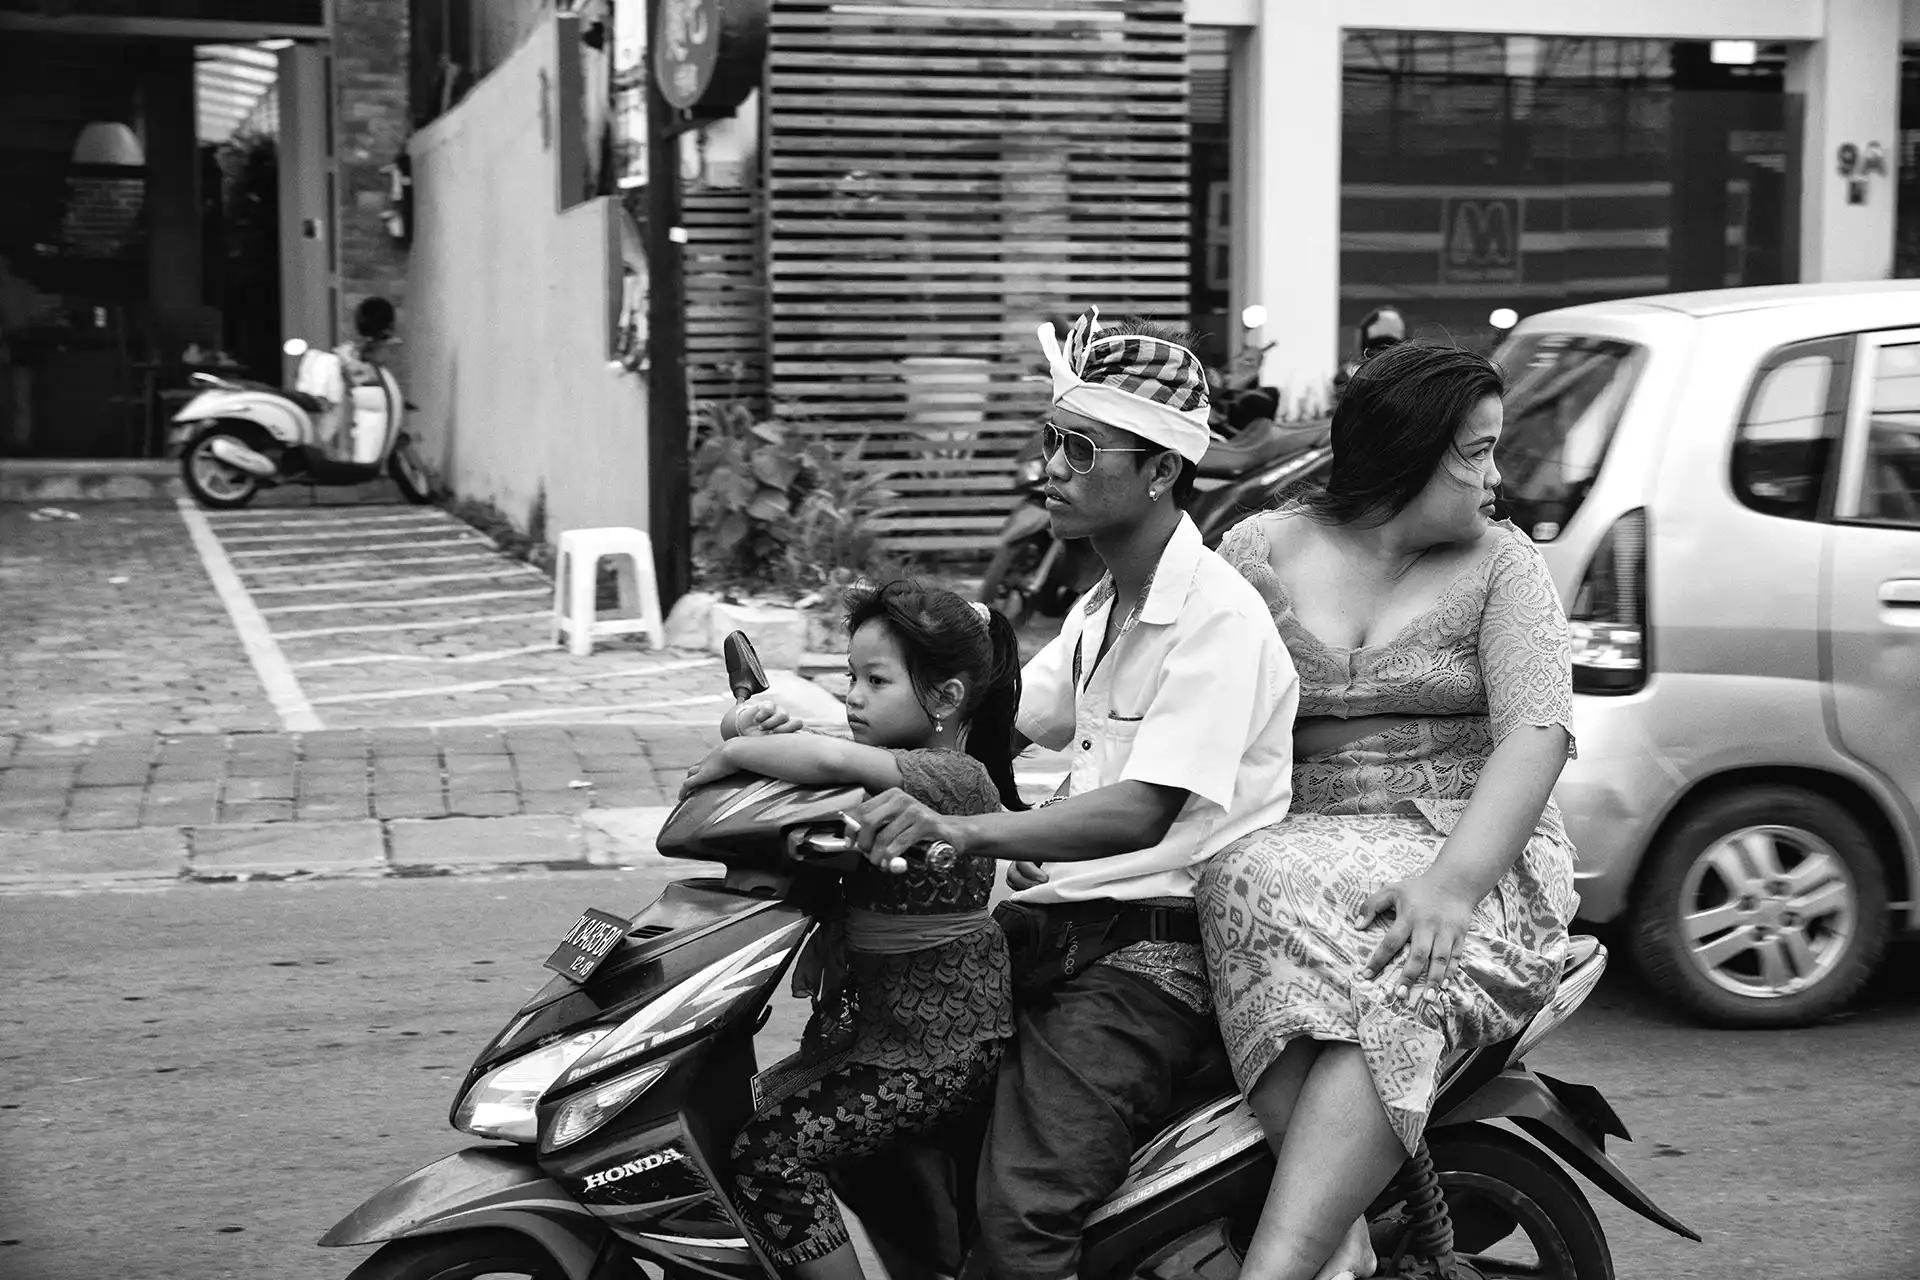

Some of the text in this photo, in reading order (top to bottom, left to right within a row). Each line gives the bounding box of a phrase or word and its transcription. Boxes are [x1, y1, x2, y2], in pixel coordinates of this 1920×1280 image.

[563, 915, 591, 944] DK
[572, 919, 612, 952] 8435
[583, 1148, 684, 1193] HONDA
[1106, 1129, 1265, 1215] LIQUID COOLED ENGIN
